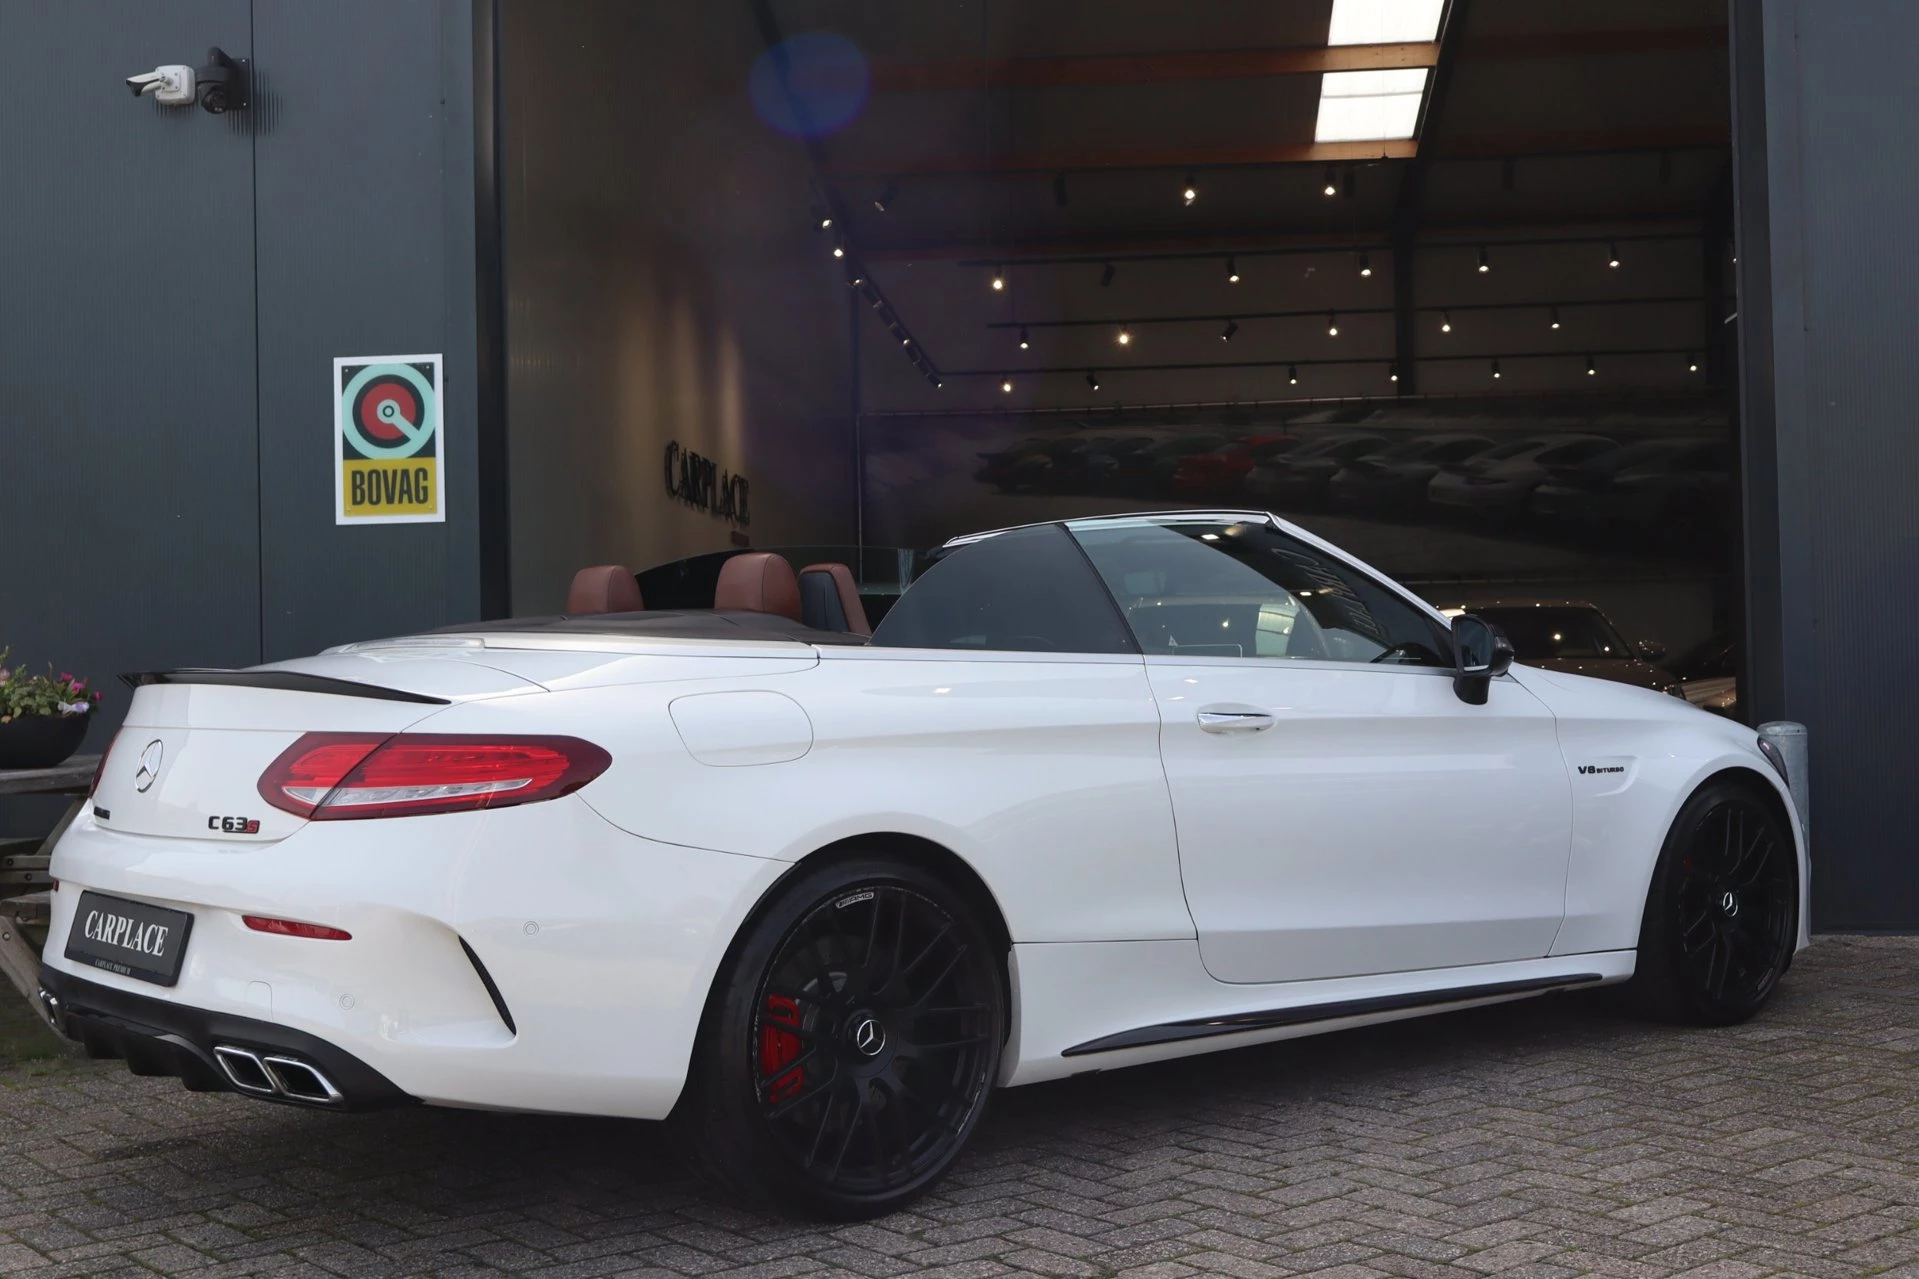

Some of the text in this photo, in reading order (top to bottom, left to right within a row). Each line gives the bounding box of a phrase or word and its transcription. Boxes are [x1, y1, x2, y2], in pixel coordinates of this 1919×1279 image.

[351, 467, 429, 506] BOVAG
[1578, 765, 1624, 774] V8 BITURBO
[84, 910, 169, 957] CARPLACE
